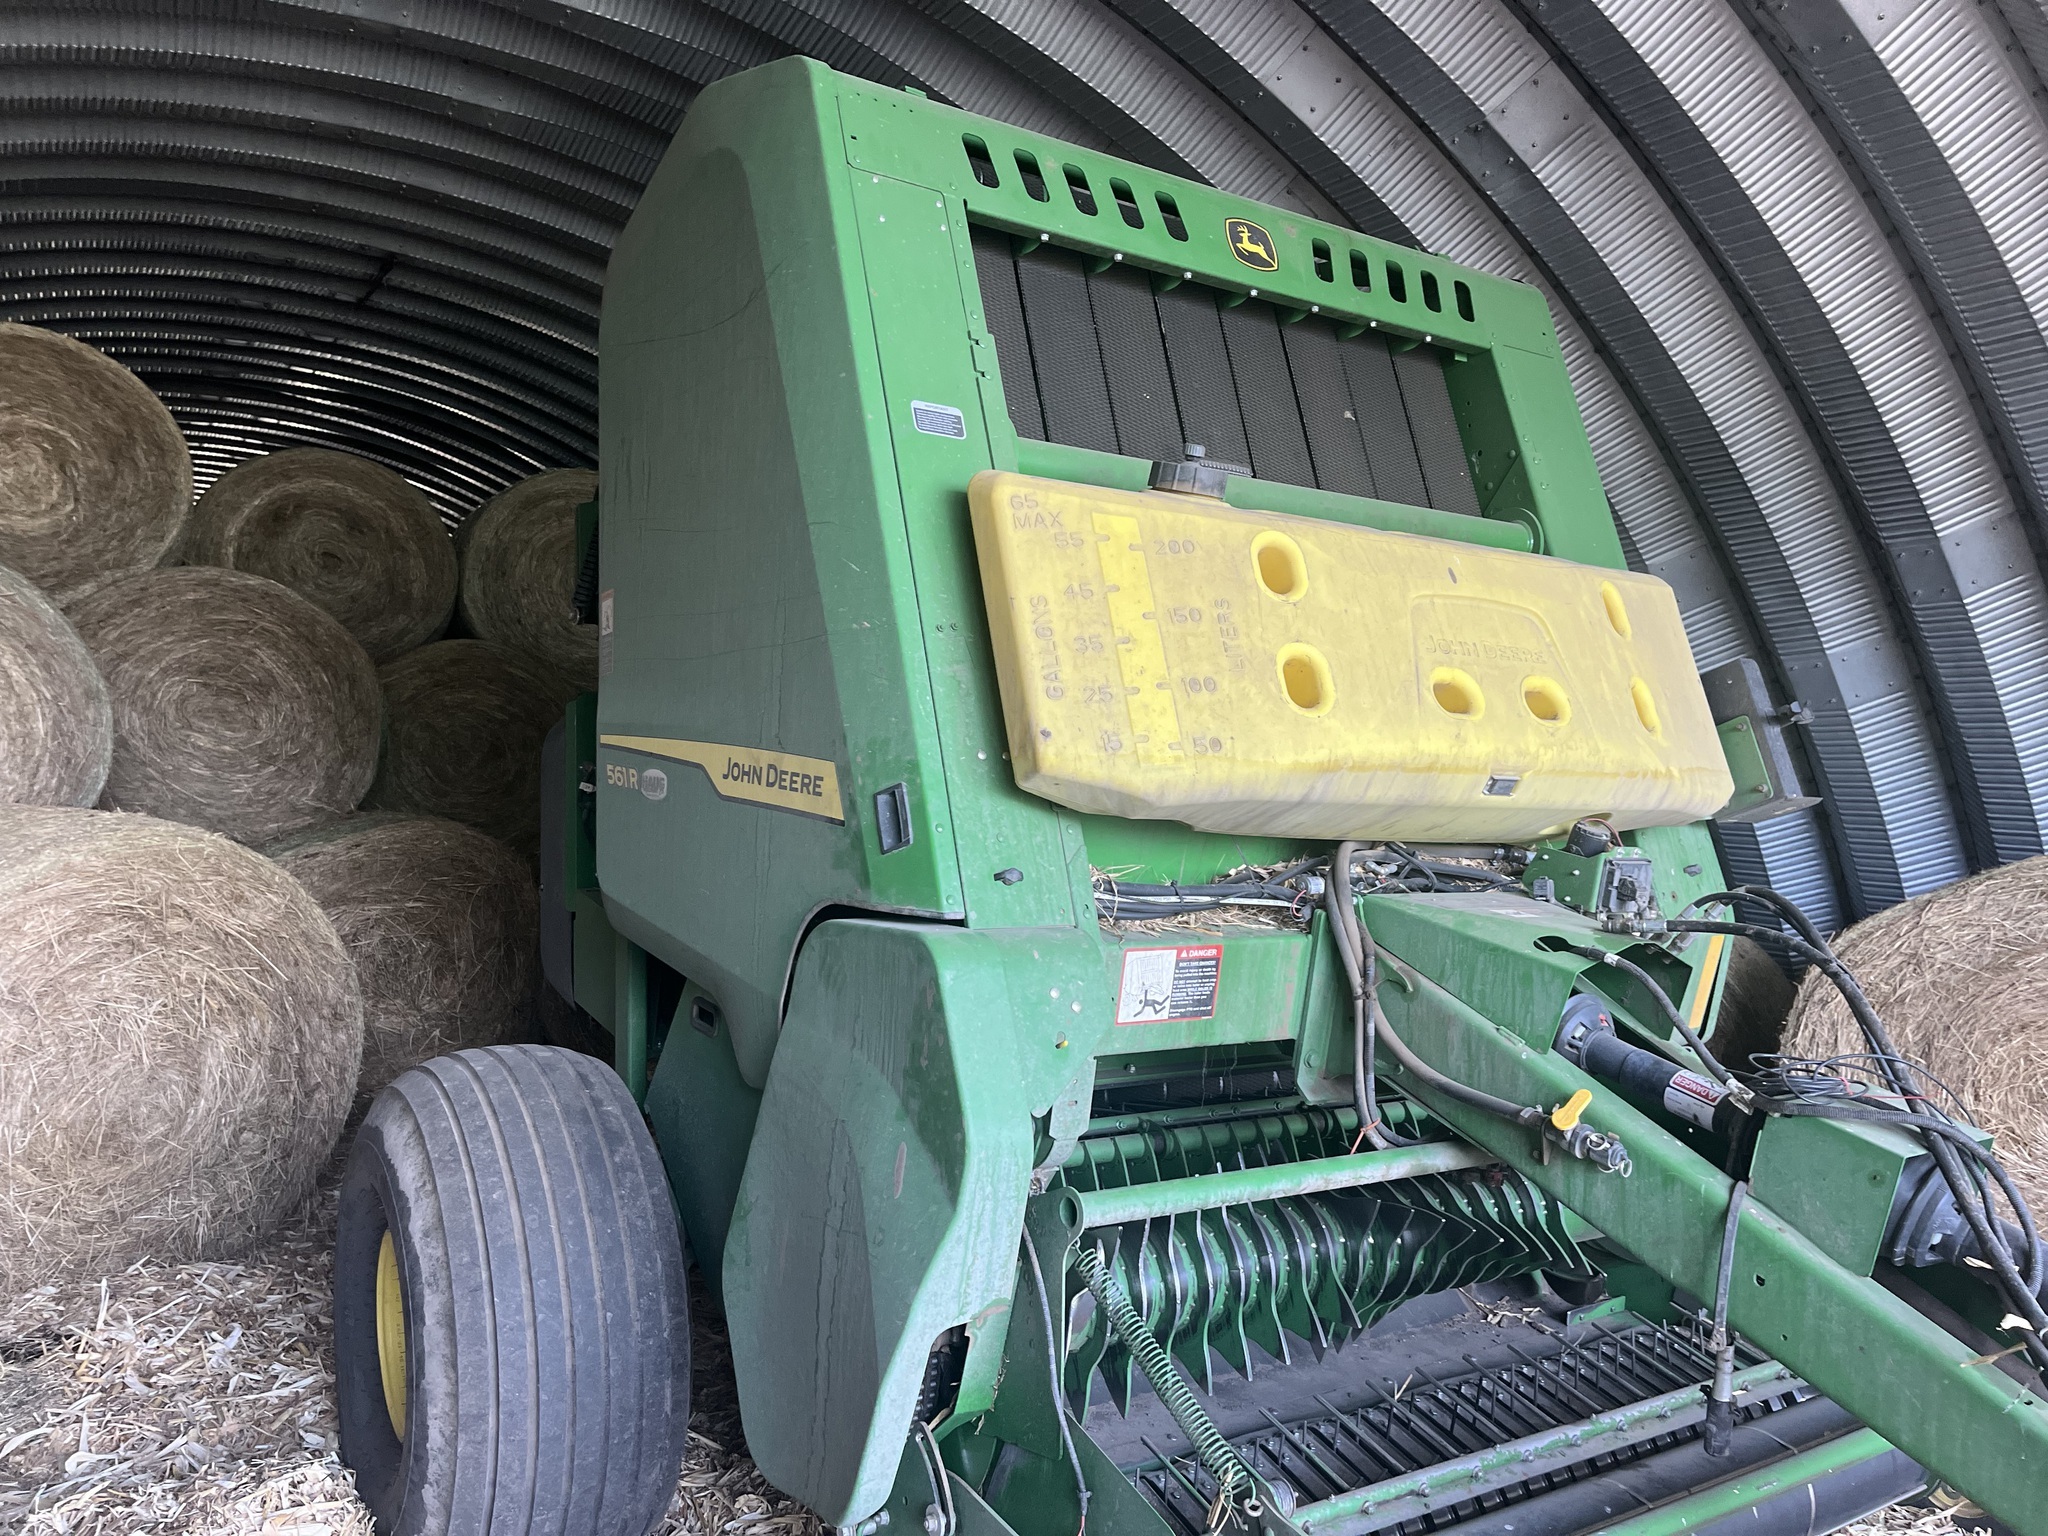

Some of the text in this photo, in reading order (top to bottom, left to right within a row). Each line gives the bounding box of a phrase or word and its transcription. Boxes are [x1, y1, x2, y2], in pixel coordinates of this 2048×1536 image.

[1010, 494, 1039, 511] 65
[1013, 511, 1064, 529] MAX
[1054, 532, 1085, 549] 55
[1154, 538, 1196, 556] 200
[1063, 582, 1095, 600] 45
[1168, 607, 1203, 624] 150
[1074, 635, 1105, 653] 35
[1213, 597, 1245, 673] LITERS
[1029, 594, 1064, 701] GALLONS
[1426, 635, 1549, 664] JOHN DEERE
[1083, 685, 1114, 704] 25
[1181, 676, 1218, 698] 100
[1100, 733, 1123, 753] 15
[1193, 735, 1223, 755] 50
[722, 757, 825, 797] JOHN DEERE
[1189, 949, 1217, 957] DANGER
[1675, 1075, 1709, 1095] DANGER
